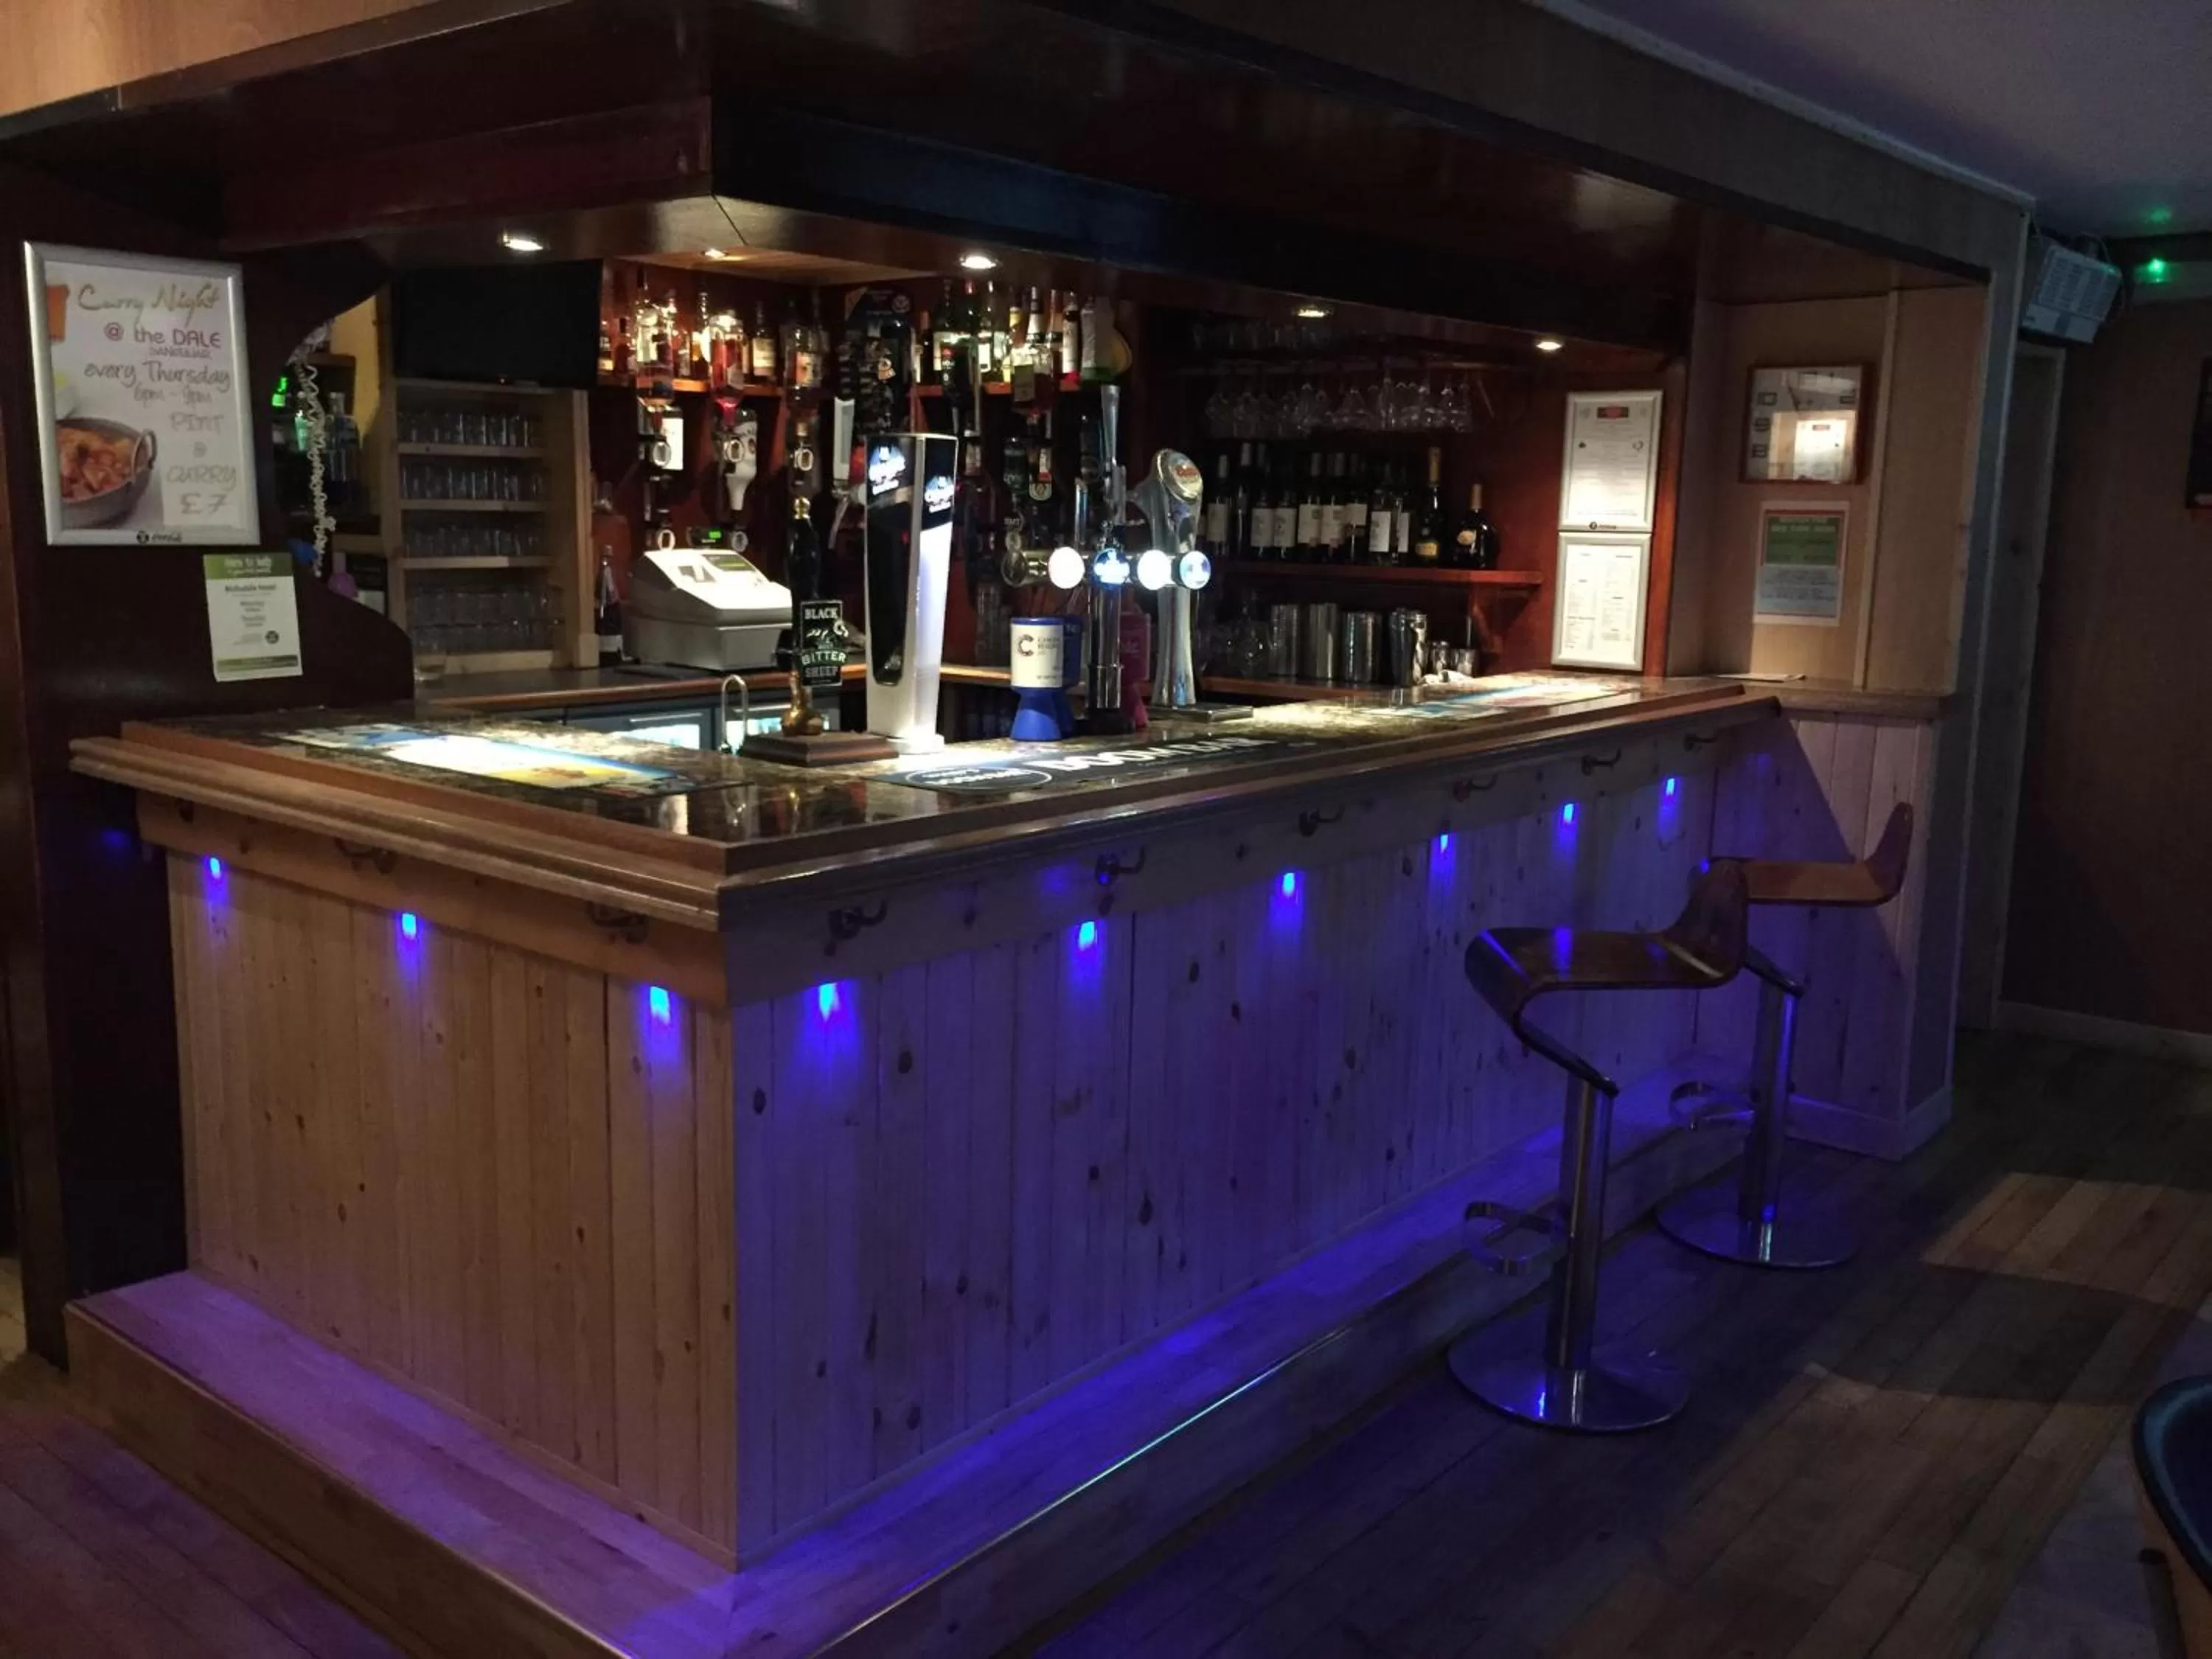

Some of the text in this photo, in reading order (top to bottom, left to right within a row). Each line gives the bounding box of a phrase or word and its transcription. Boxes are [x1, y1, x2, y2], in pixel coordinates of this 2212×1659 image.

[78, 282, 220, 328] Curry Night
[103, 321, 222, 349] @ the DALE
[84, 360, 231, 393] every Thursday
[804, 607, 838, 619] BLACK
[801, 650, 846, 665] BITTER
